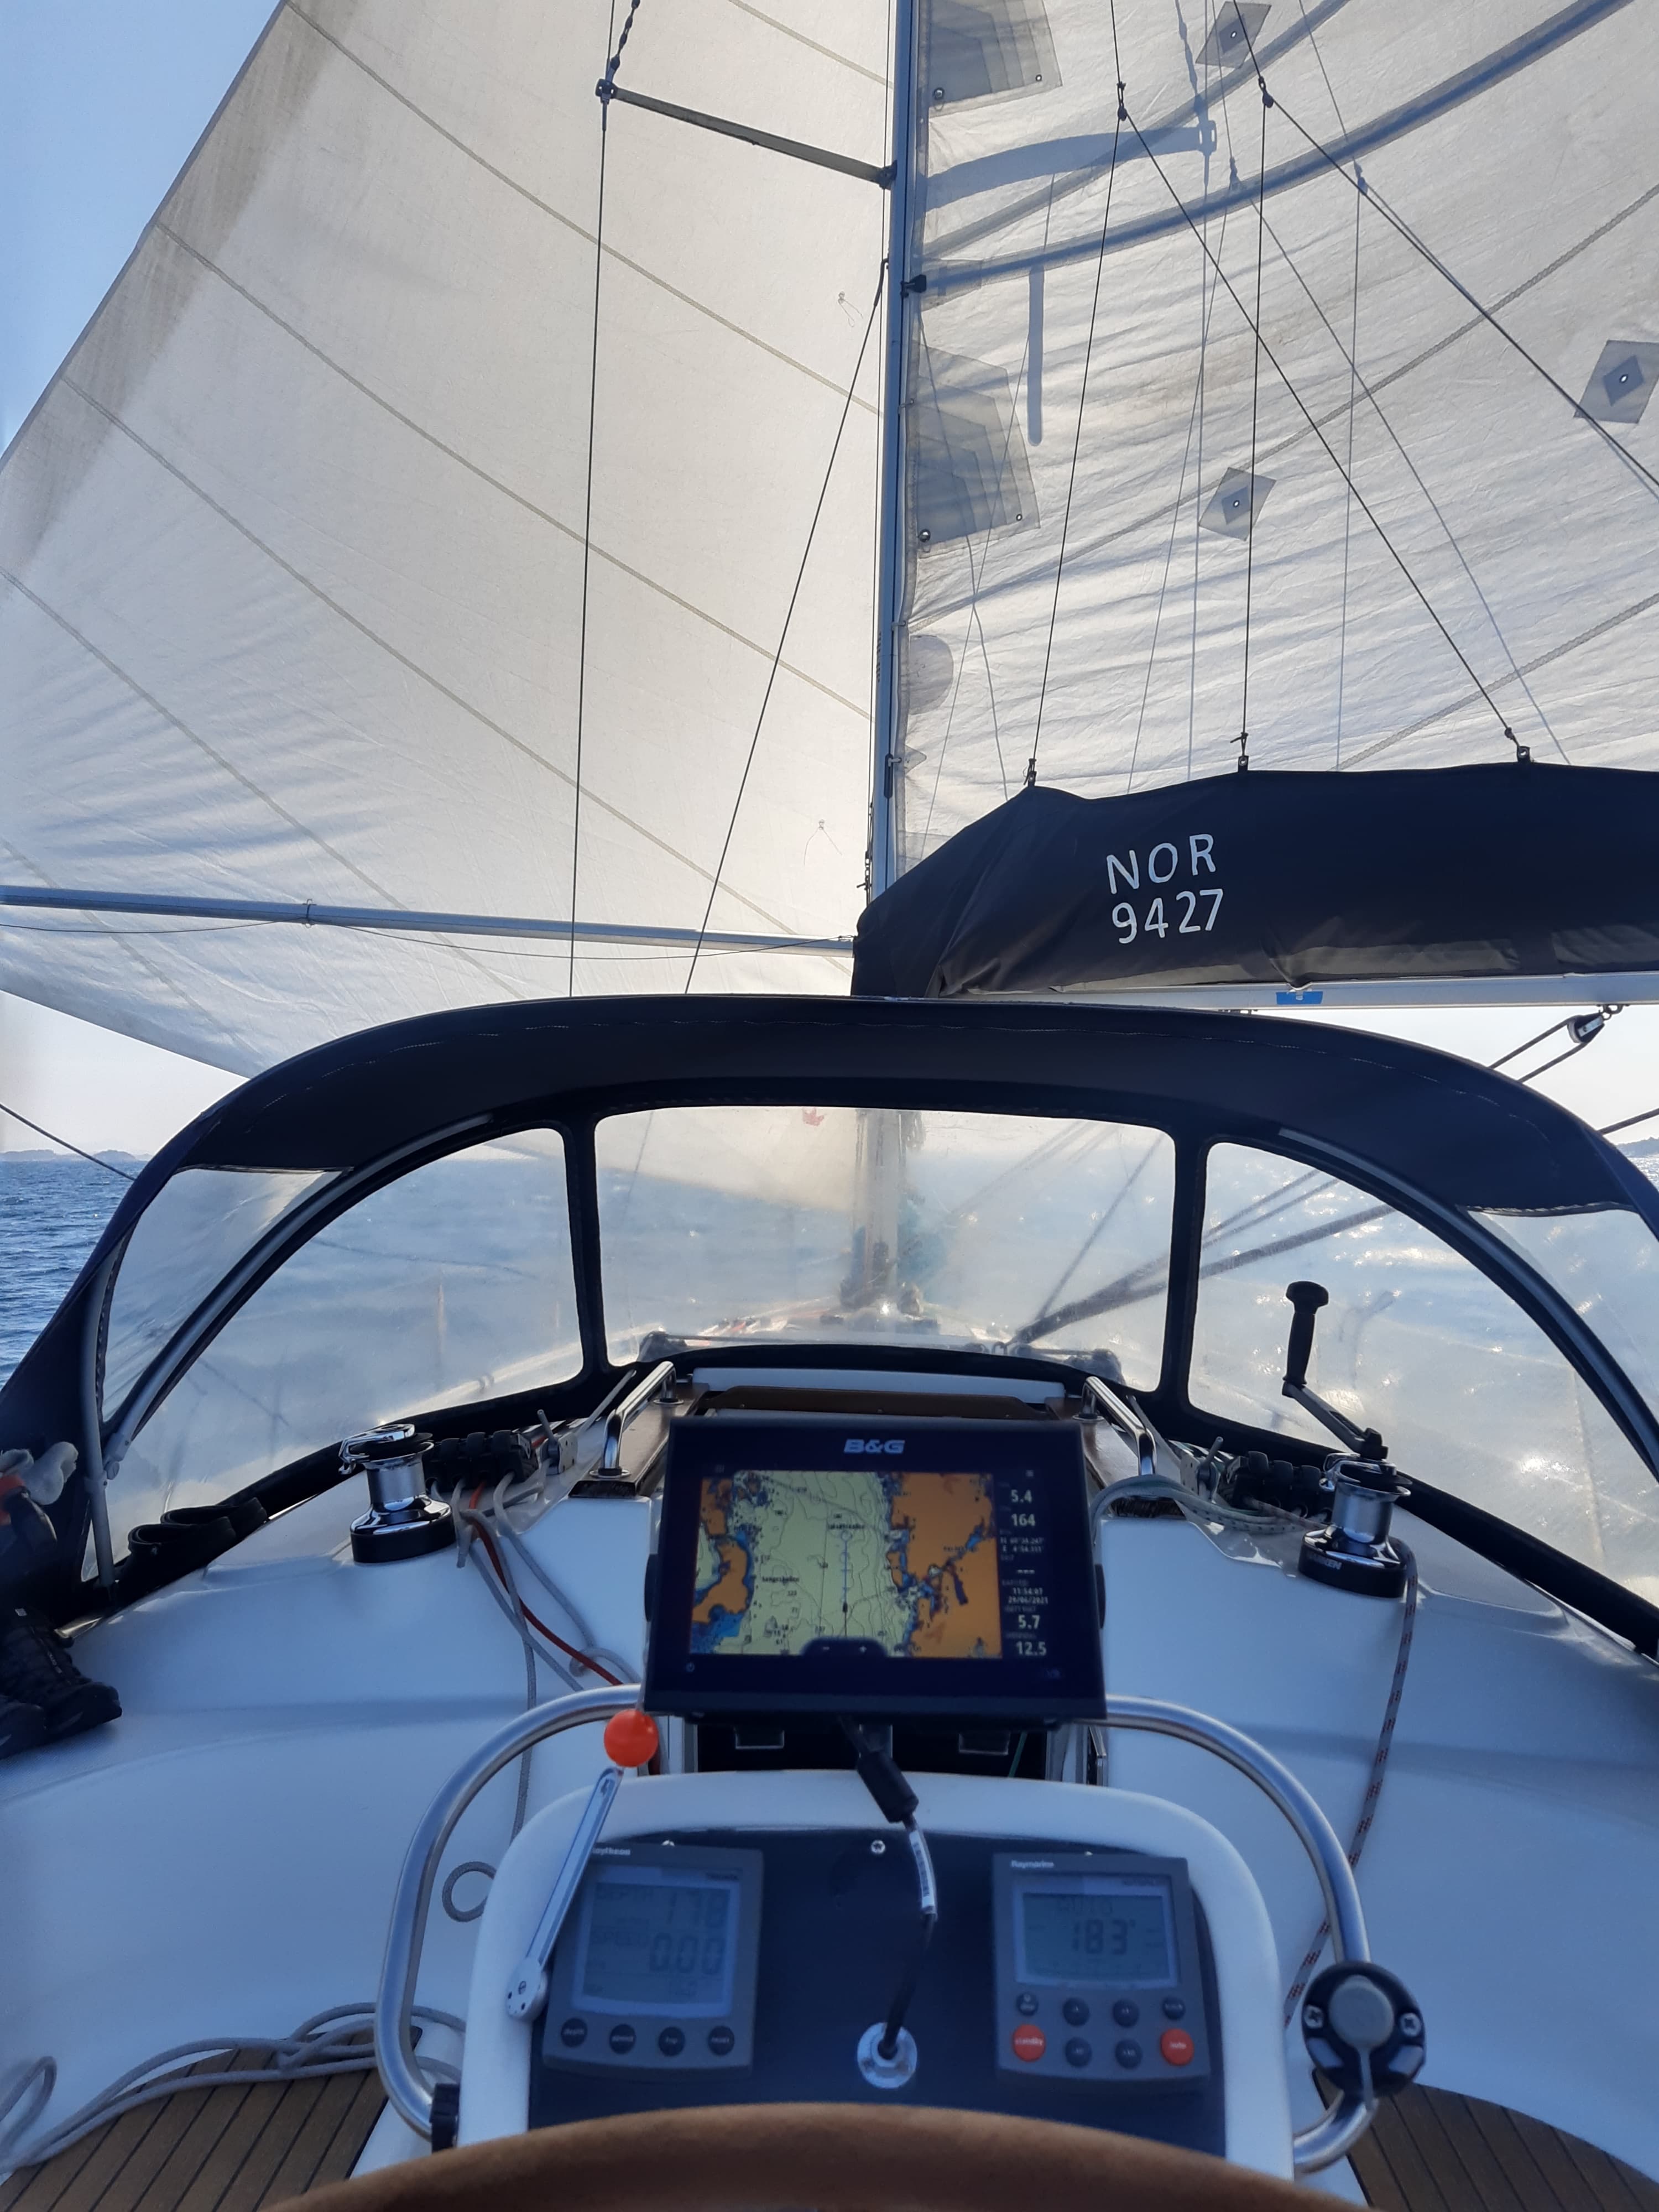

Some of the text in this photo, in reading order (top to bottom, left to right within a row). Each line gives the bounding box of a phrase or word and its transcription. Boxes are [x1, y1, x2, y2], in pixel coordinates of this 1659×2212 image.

[1107, 834, 1215, 894] NOR
[1112, 888, 1223, 943] 9427
[843, 1438, 905, 1454] B&G
[1011, 1489, 1032, 1503] 5.4
[1011, 1514, 1036, 1526] 164
[1018, 1614, 1040, 1629] 5.7
[1016, 1641, 1047, 1656] 12.5
